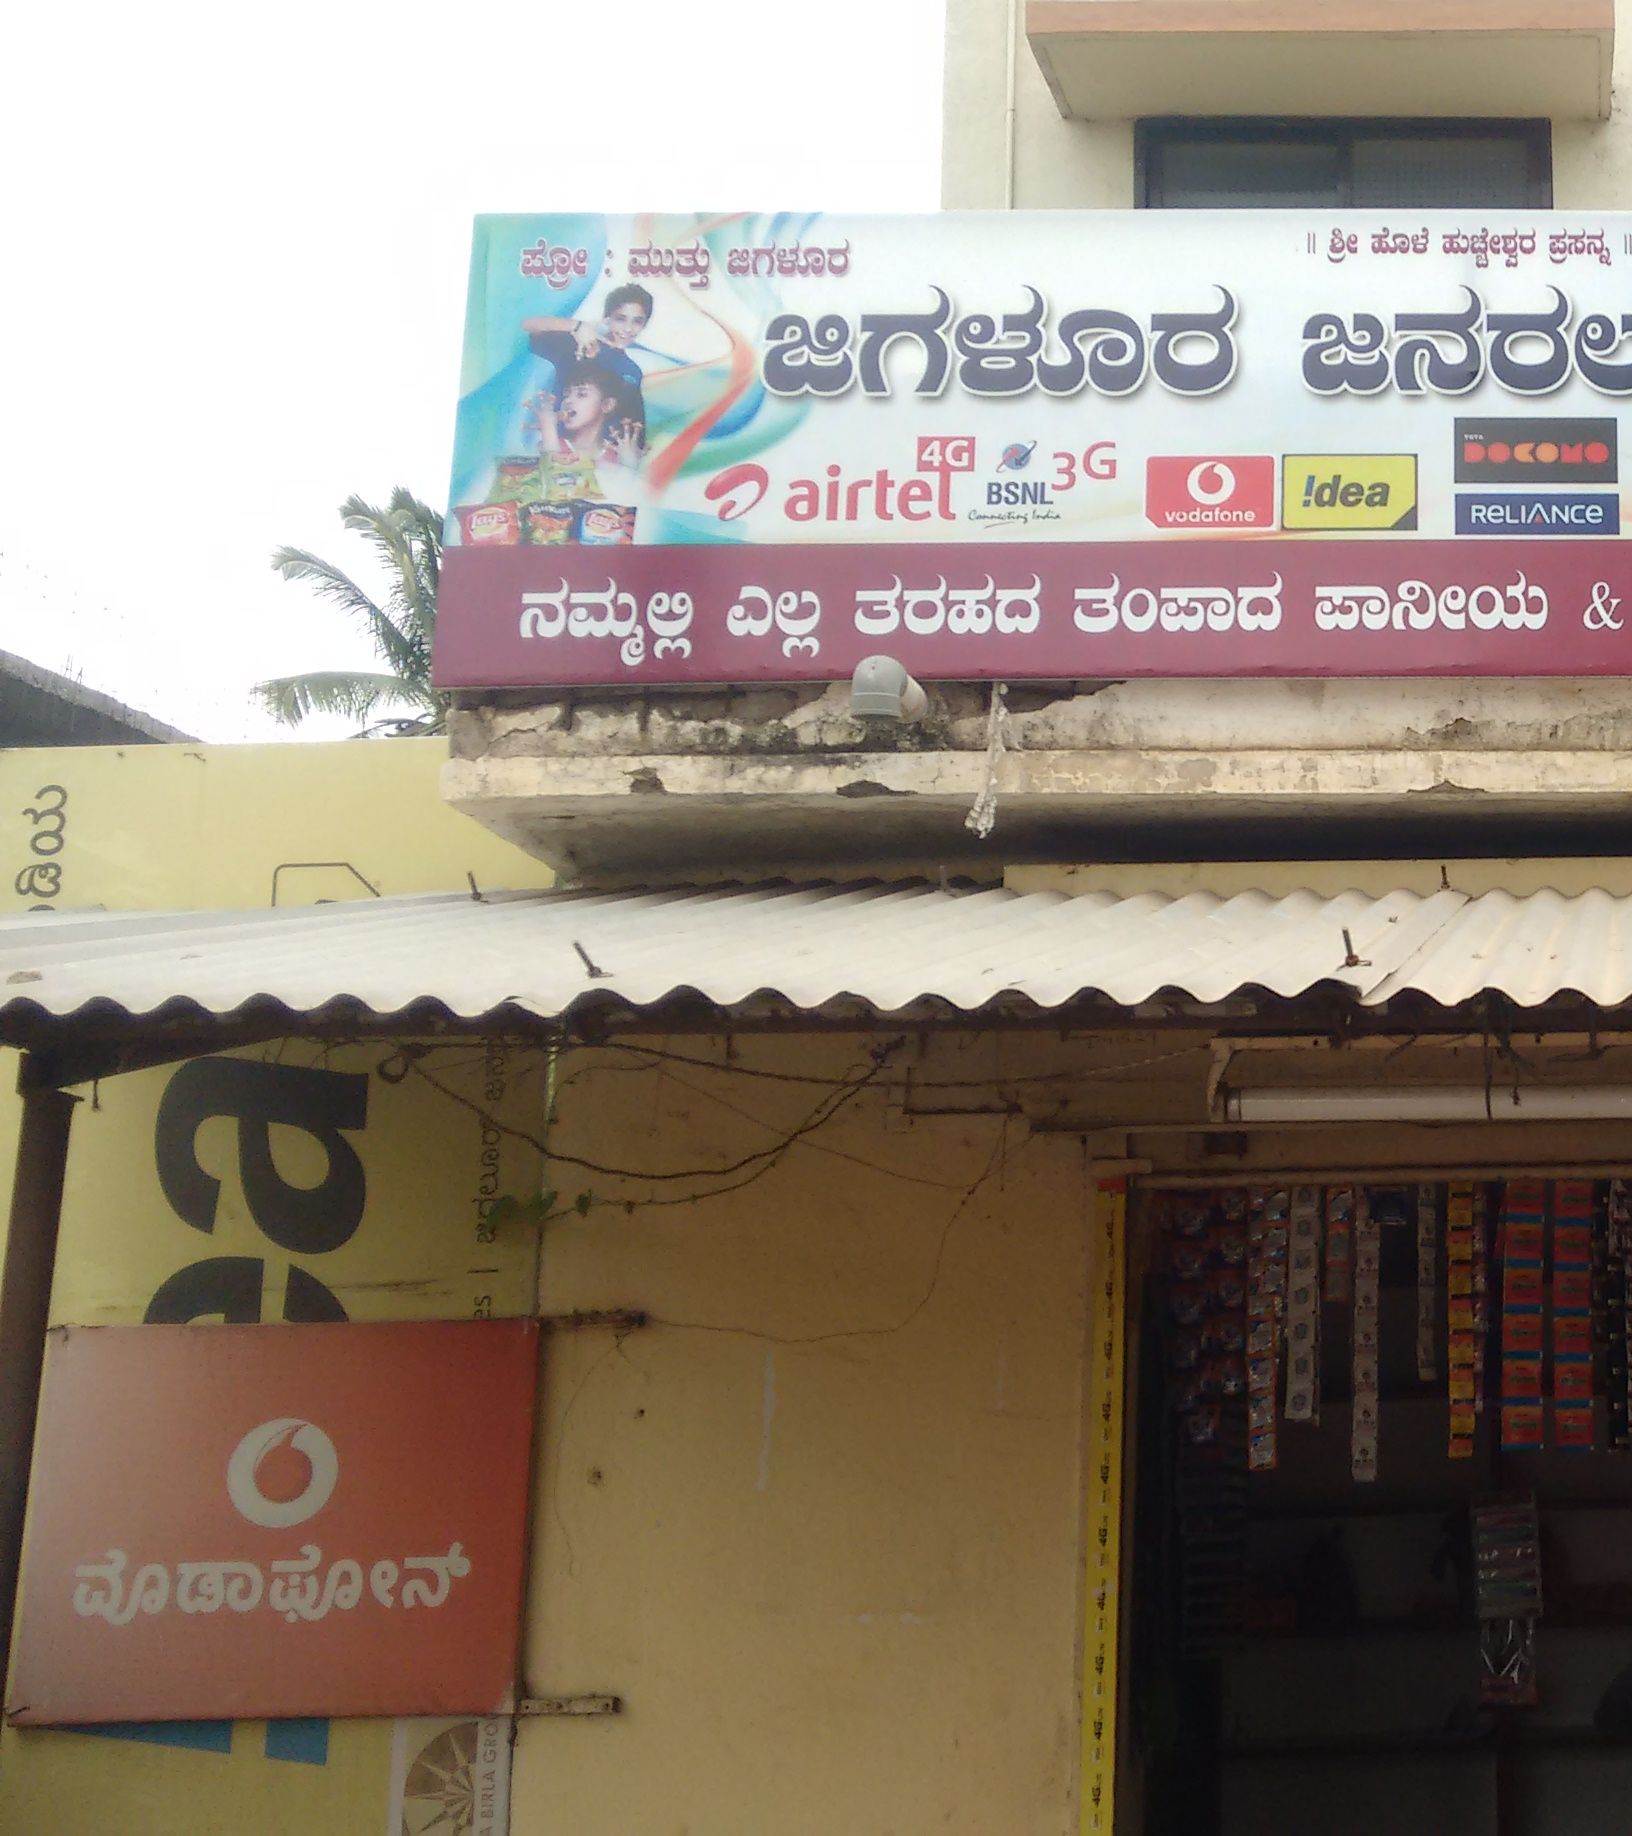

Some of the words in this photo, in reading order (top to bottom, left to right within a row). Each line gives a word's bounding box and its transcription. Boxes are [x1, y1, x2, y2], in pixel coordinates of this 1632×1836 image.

[628, 238, 712, 290] ಮುತ್ತು
[726, 238, 852, 278] ಜಿಗಳೂರ
[1328, 227, 1358, 263] ಶ್ರೀ
[1371, 227, 1430, 254] ಹೊಳೆ
[1548, 227, 1612, 266] ಪ್ರಸನ್ನ
[762, 284, 1240, 396] ಜಿಗಳೂರ
[921, 439, 971, 468] 4G
[1051, 441, 1117, 492] 3G
[1464, 441, 1610, 465] DOCOMO
[784, 463, 957, 522] airtel
[968, 508, 1028, 525] Connecting
[1031, 508, 1062, 522] India
[986, 481, 1054, 506] BSNL
[1165, 509, 1257, 524] vodafone
[520, 576, 694, 666] ನಮ್ಮಲ್ಲಿ
[727, 584, 822, 658] ಎಲ್ಲ
[855, 574, 1040, 634] ತರಹದ
[1073, 571, 1283, 633] ತಂಪಾದ
[1315, 571, 1549, 631] ಪಾನೀಯ
[1583, 581, 1624, 631] &
[14, 784, 69, 912] ಡಿಯ
[480, 1769, 497, 1819] BIRLA
